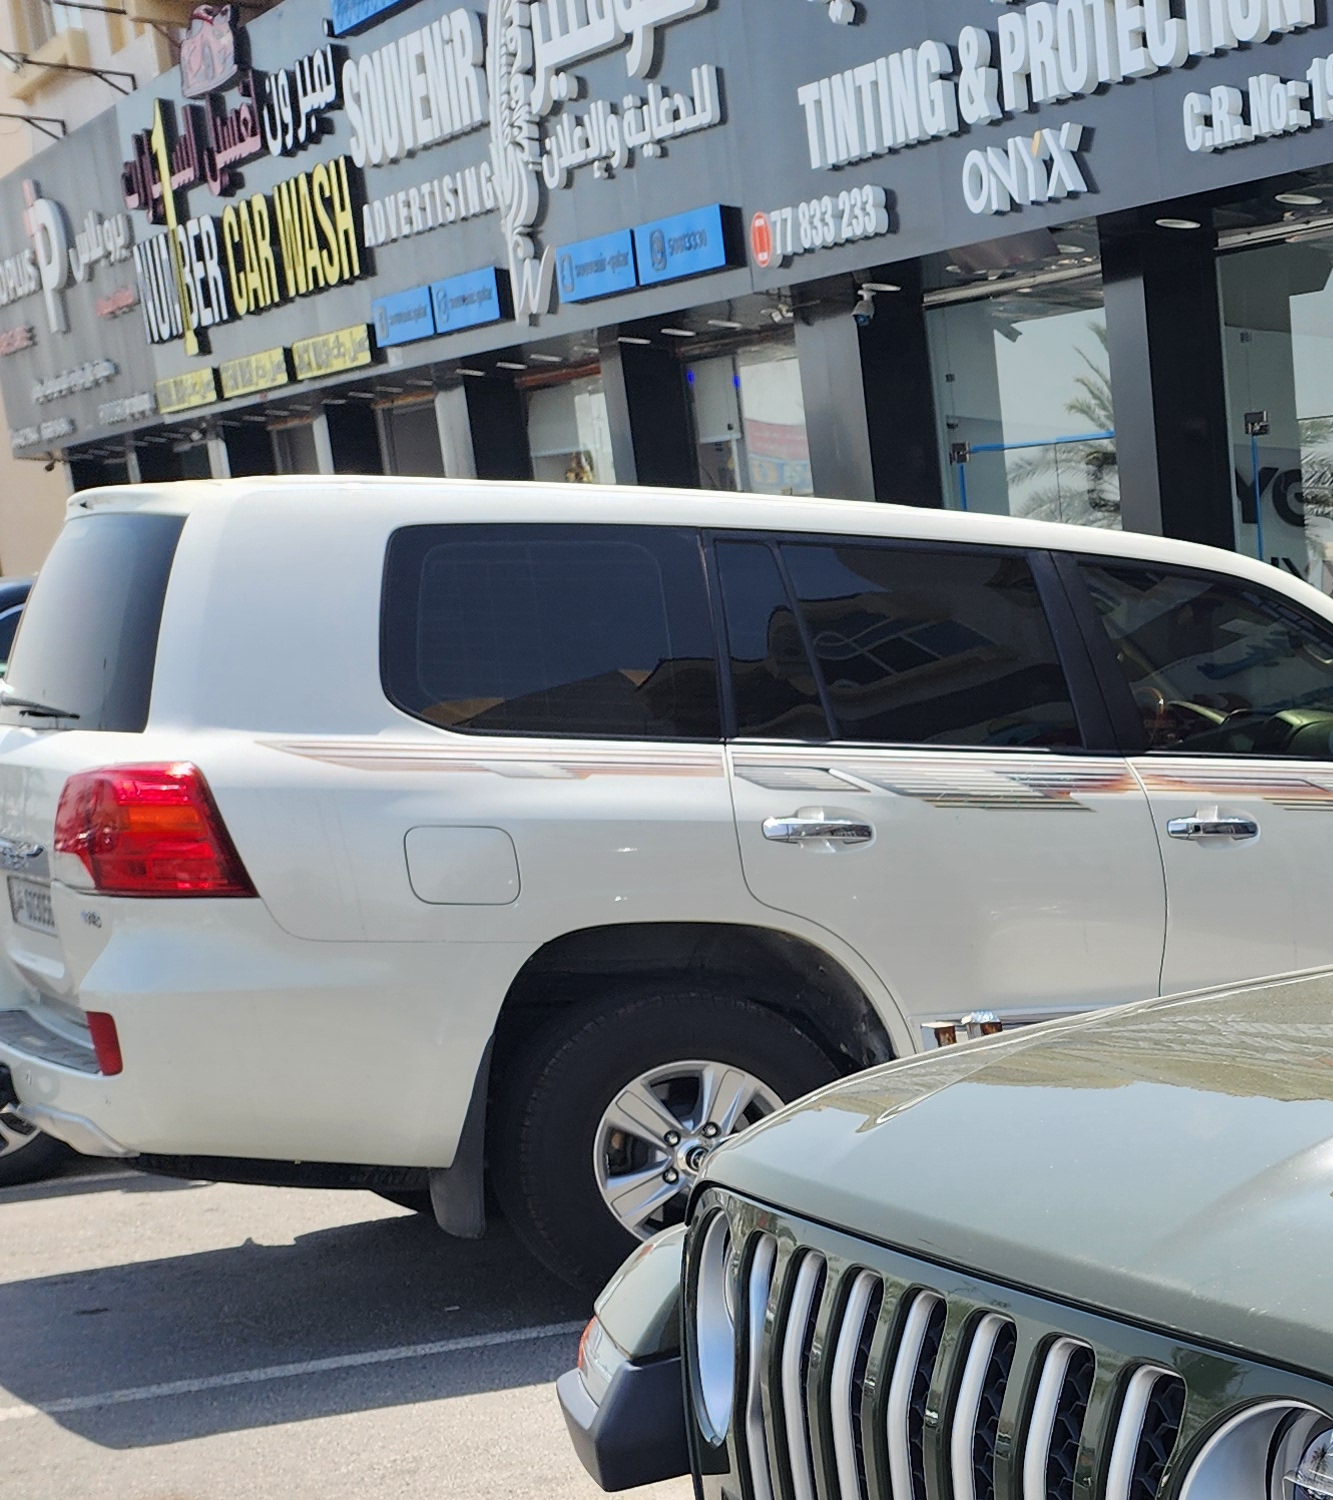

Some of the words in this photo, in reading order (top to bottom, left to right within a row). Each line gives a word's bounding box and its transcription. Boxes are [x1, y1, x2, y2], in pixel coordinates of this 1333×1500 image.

[623, 64, 721, 158] للدعاية
[798, 40, 959, 169] TINTING
[958, 26, 1003, 125] &
[998, 0, 1315, 112] PROTEC
[362, 161, 499, 249] ADVERTISING
[962, 122, 1087, 215] ONYX
[222, 192, 280, 316] CAR
[272, 154, 361, 298] WASH
[770, 207, 794, 256] 77
[798, 194, 837, 250] 833
[838, 184, 889, 240] 233
